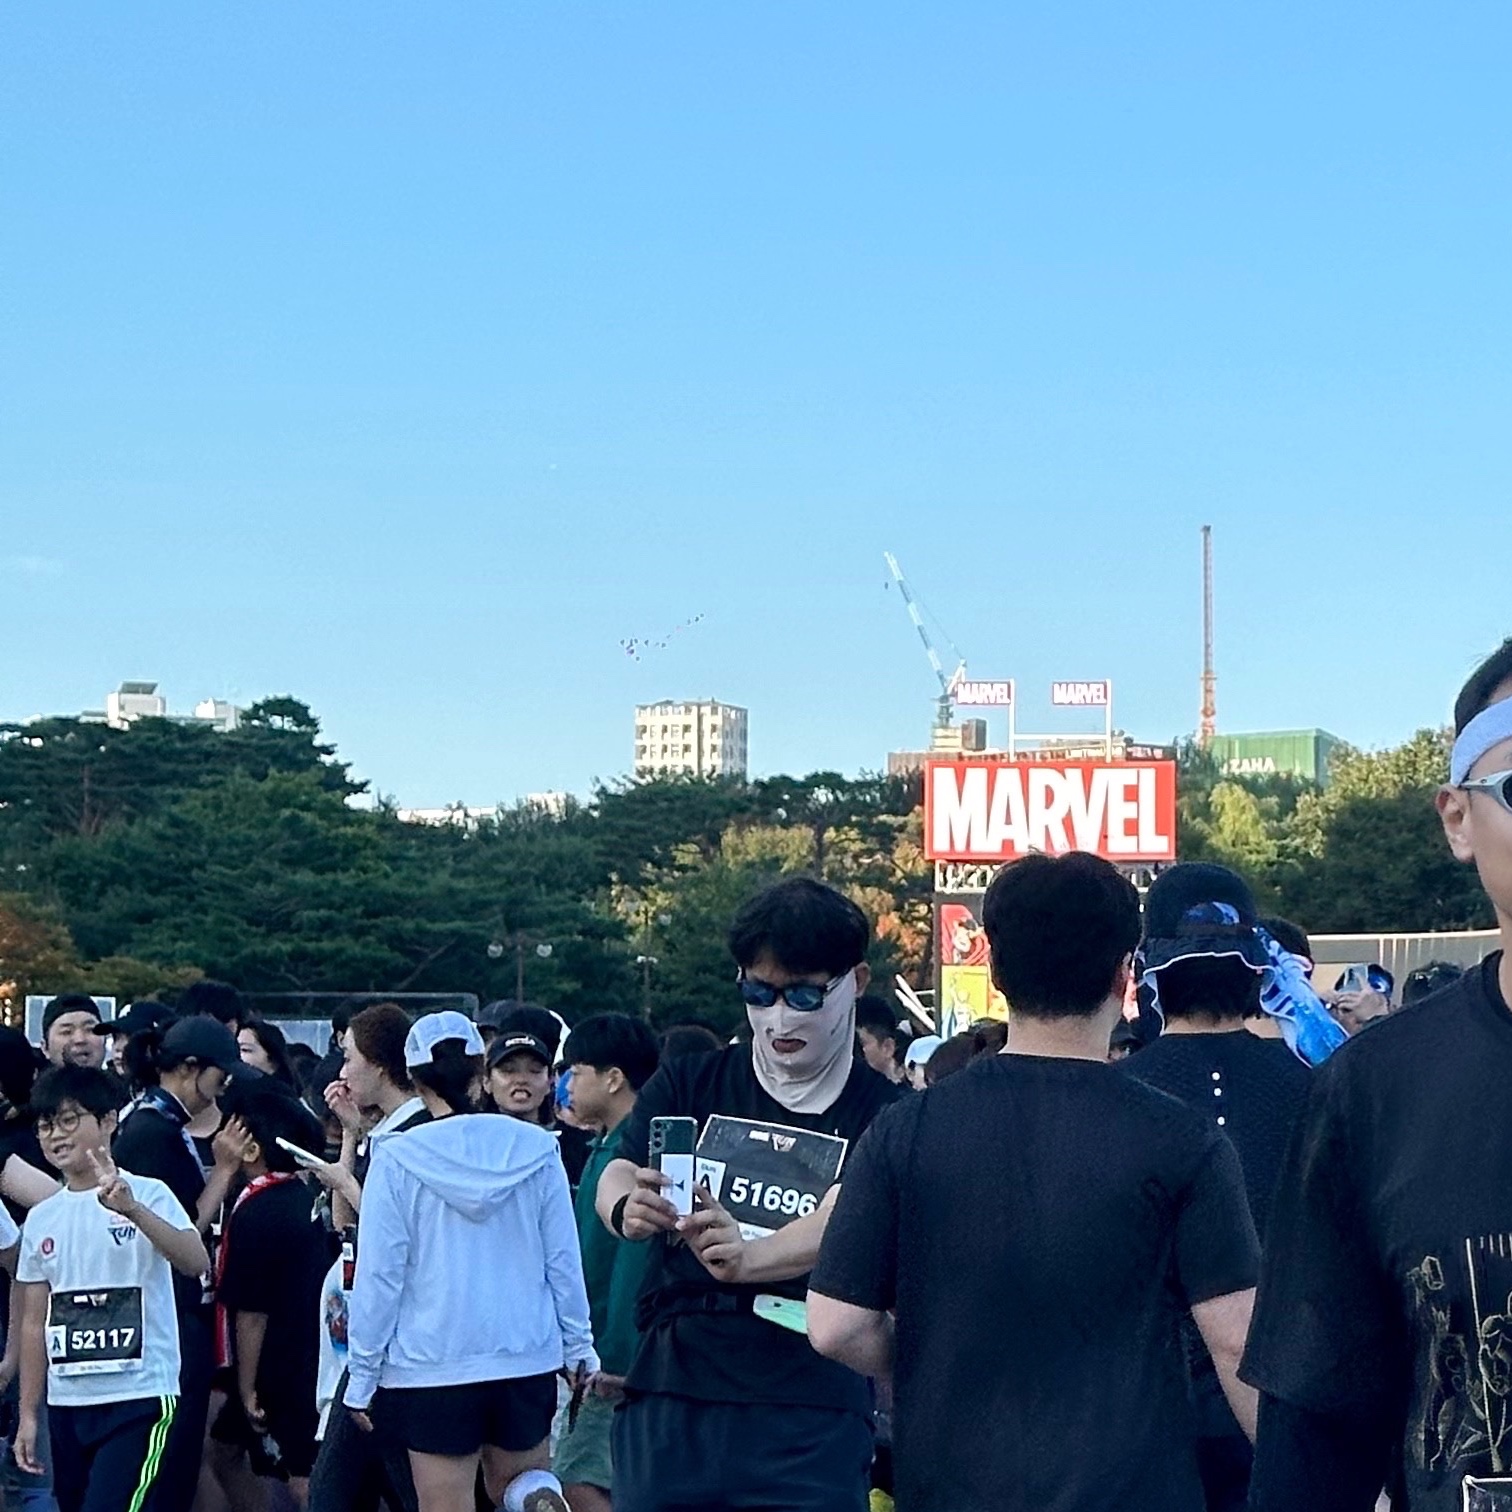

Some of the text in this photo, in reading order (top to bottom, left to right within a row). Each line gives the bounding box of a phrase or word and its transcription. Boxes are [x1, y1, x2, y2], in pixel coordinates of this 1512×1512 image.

[957, 682, 1010, 704] MARVEL
[1053, 682, 1107, 704] MARVEL
[932, 766, 1169, 853] MARVEL
[729, 1176, 818, 1218] 51696
[52, 1335, 62, 1351] A
[71, 1327, 135, 1350] 52117
